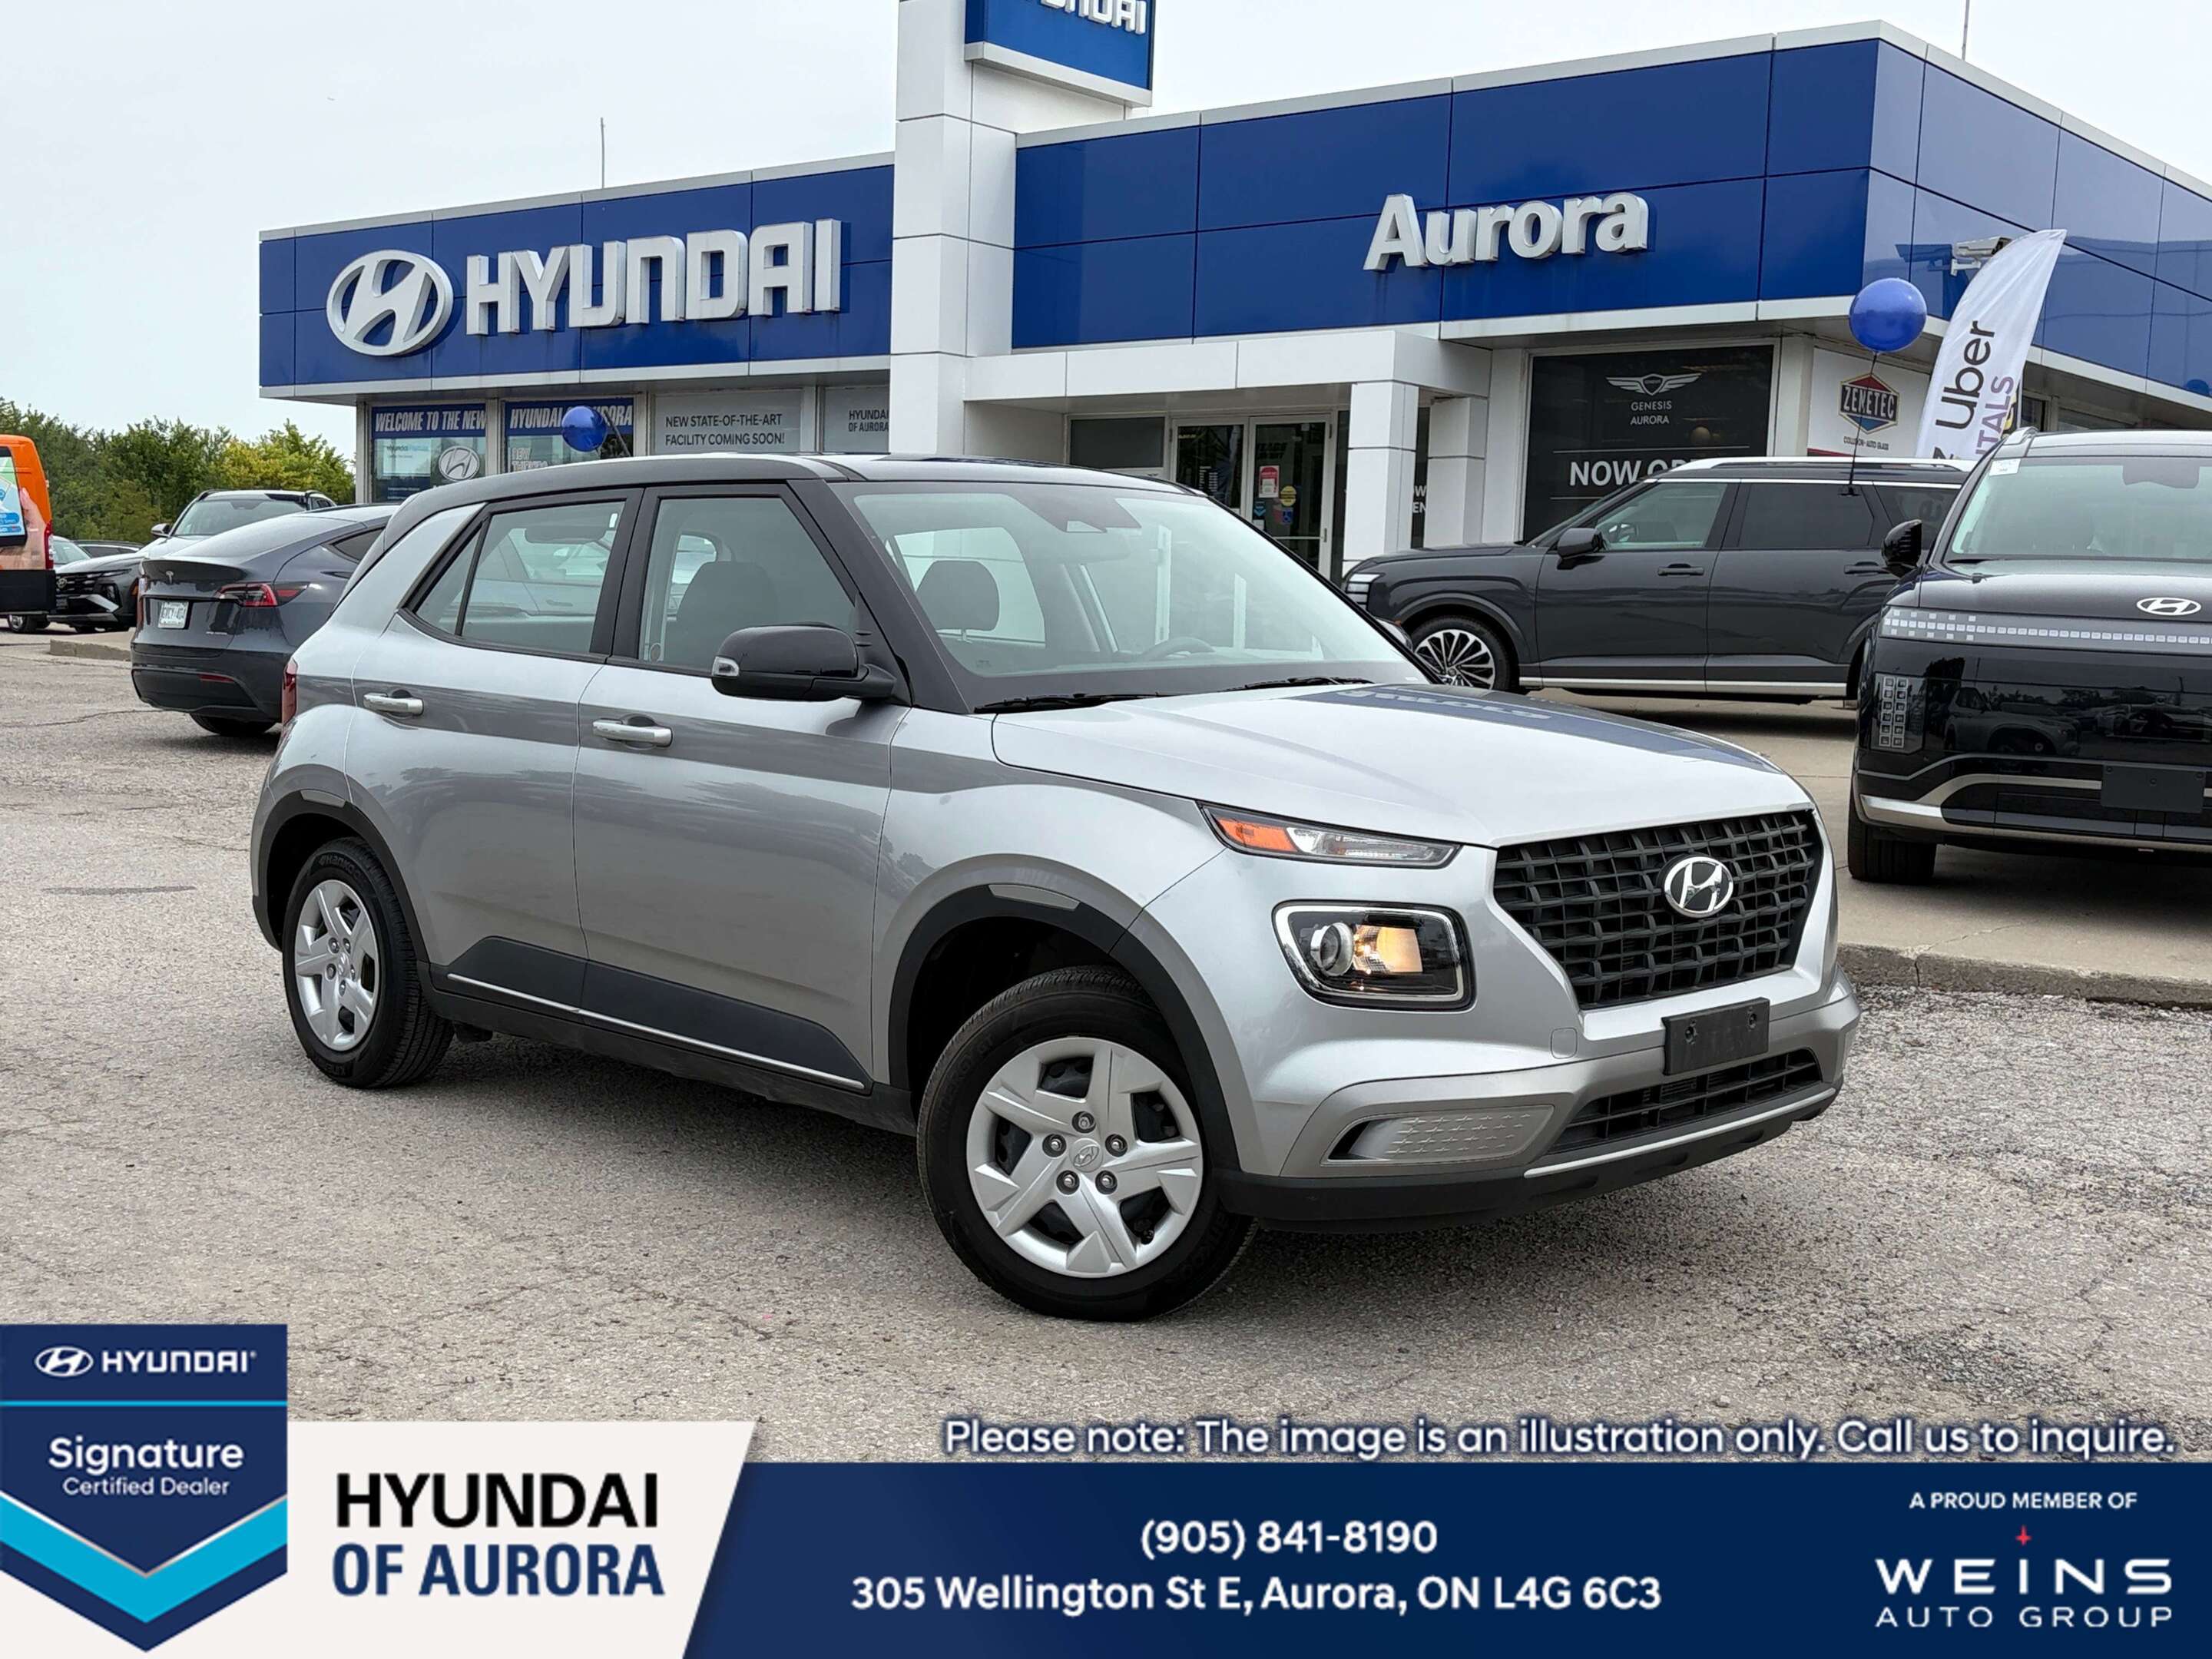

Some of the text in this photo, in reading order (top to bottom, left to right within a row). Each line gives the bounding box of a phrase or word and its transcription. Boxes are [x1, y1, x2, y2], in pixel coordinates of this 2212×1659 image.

[1363, 192, 1649, 271] Aurora
[466, 218, 842, 336] HYUNDAI
[1936, 320, 1995, 429] Uber
[1631, 400, 1672, 411] GENESIS
[1843, 386, 1895, 419] ZENETEC
[375, 409, 485, 432] WELCOME TO THE NEW
[510, 407, 563, 429] HYUNDAI
[665, 413, 782, 428] NEW STATE-OF-THE-ART
[849, 409, 889, 421] HYUNDAI
[1630, 415, 1669, 426] AURORA
[848, 422, 889, 432] OF AURORA
[665, 433, 785, 446] FACILITY COMING SOON!
[1570, 460, 1642, 486] NOW
